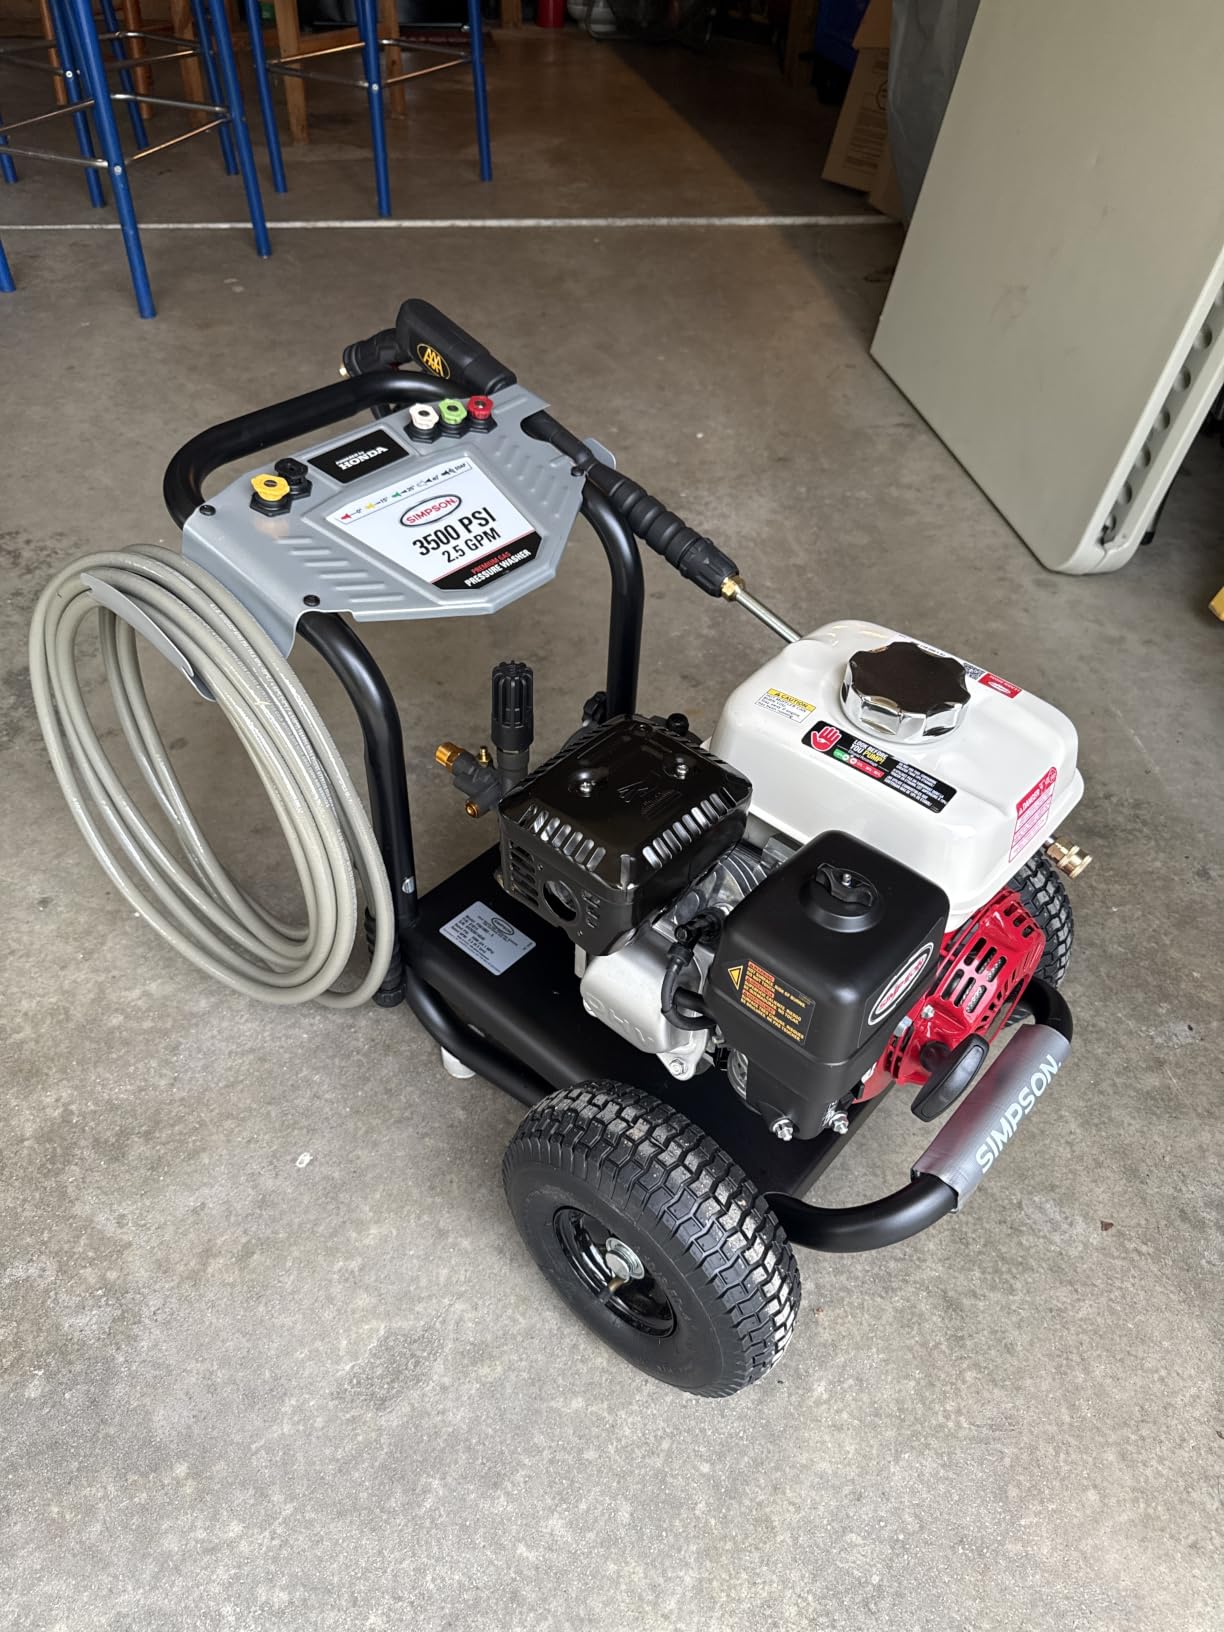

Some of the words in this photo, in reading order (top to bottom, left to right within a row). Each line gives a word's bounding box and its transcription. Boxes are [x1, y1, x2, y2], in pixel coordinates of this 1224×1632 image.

[338, 446, 389, 470] HONDA
[406, 498, 457, 524] SIMPSON
[412, 524, 461, 556] 3500
[458, 507, 497, 534] PSI
[442, 544, 466, 563] 2.5
[464, 527, 502, 552] GPM
[464, 564, 504, 587] PRESSURE
[499, 549, 532, 568] WASHER
[471, 557, 500, 574] PREMIUM
[497, 551, 512, 562] GAS
[781, 694, 809, 708] CAUTION
[850, 743, 864, 754] YOU
[862, 750, 885, 765] PUMP!
[853, 740, 869, 750] LOOK
[867, 746, 888, 759] BEFORE
[879, 957, 925, 1009] SIMPSON
[976, 1054, 1060, 1174] SIMPSON
